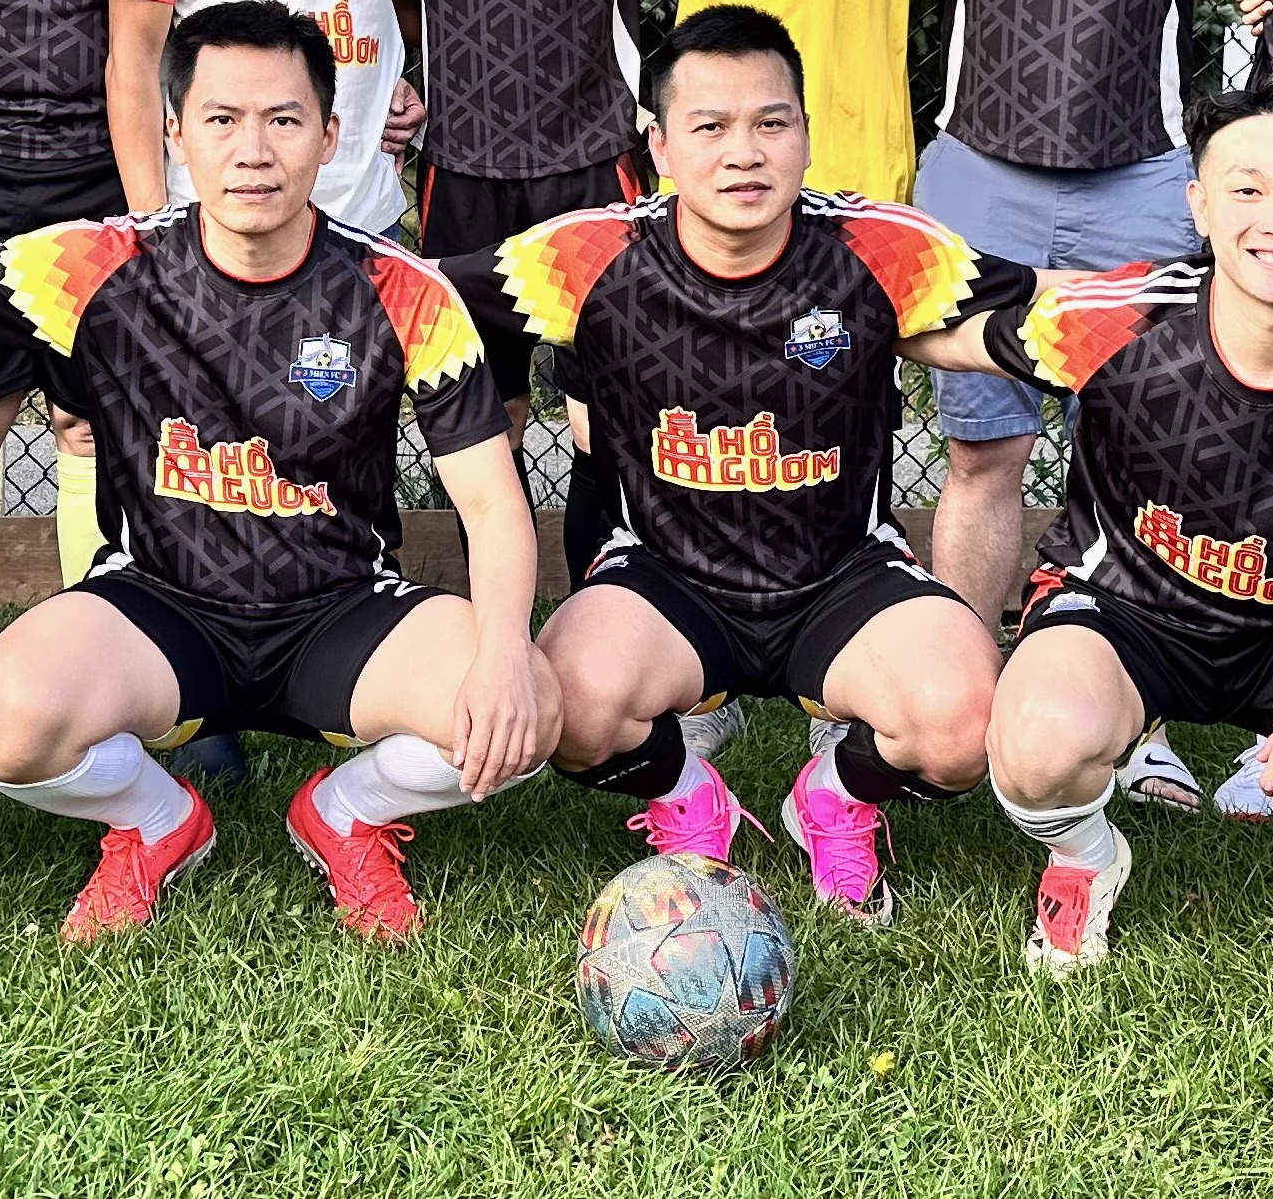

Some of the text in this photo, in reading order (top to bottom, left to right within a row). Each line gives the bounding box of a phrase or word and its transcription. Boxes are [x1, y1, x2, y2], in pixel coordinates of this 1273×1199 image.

[334, 35, 380, 65] ƯƠM
[717, 413, 778, 457] HỒ
[219, 438, 273, 478] HỒ
[719, 445, 840, 486] GƯƠM
[1200, 538, 1265, 577] HỒ
